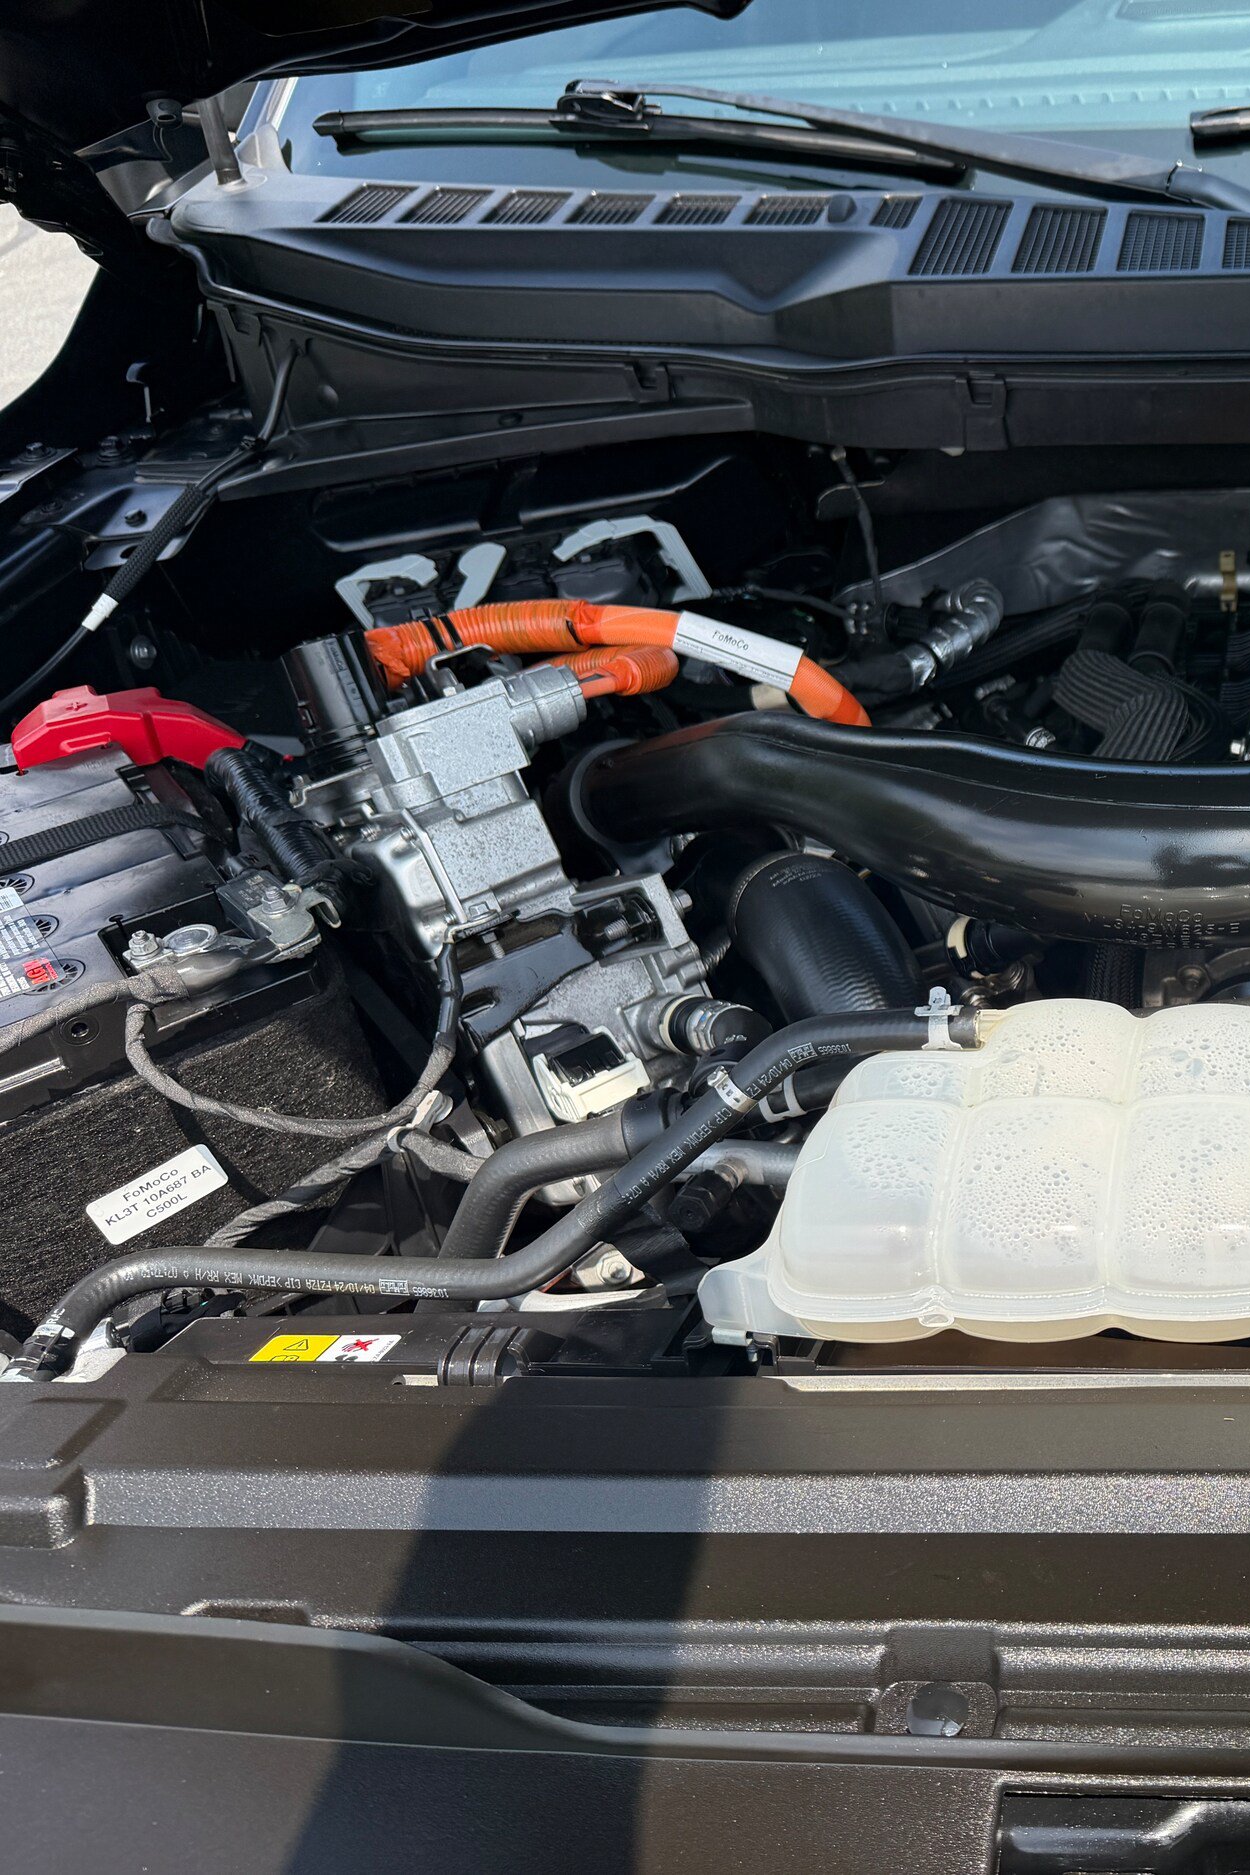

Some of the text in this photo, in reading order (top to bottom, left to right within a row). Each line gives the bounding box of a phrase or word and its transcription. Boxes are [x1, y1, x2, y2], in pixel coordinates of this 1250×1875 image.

[712, 630, 749, 651] FoMoCo
[1120, 903, 1203, 922] FoMoCo
[757, 1057, 793, 1087] 04/10/24
[716, 1106, 732, 1125] CIP
[668, 1147, 686, 1164] MEX
[123, 1168, 179, 1202] FoMoCo
[105, 1164, 211, 1226] KL3T 10A687 BA
[146, 1193, 188, 1218] C500L
[224, 1271, 243, 1285] MEX
[284, 1277, 301, 1289] CIP
[334, 1280, 376, 1295] 04/10/24
